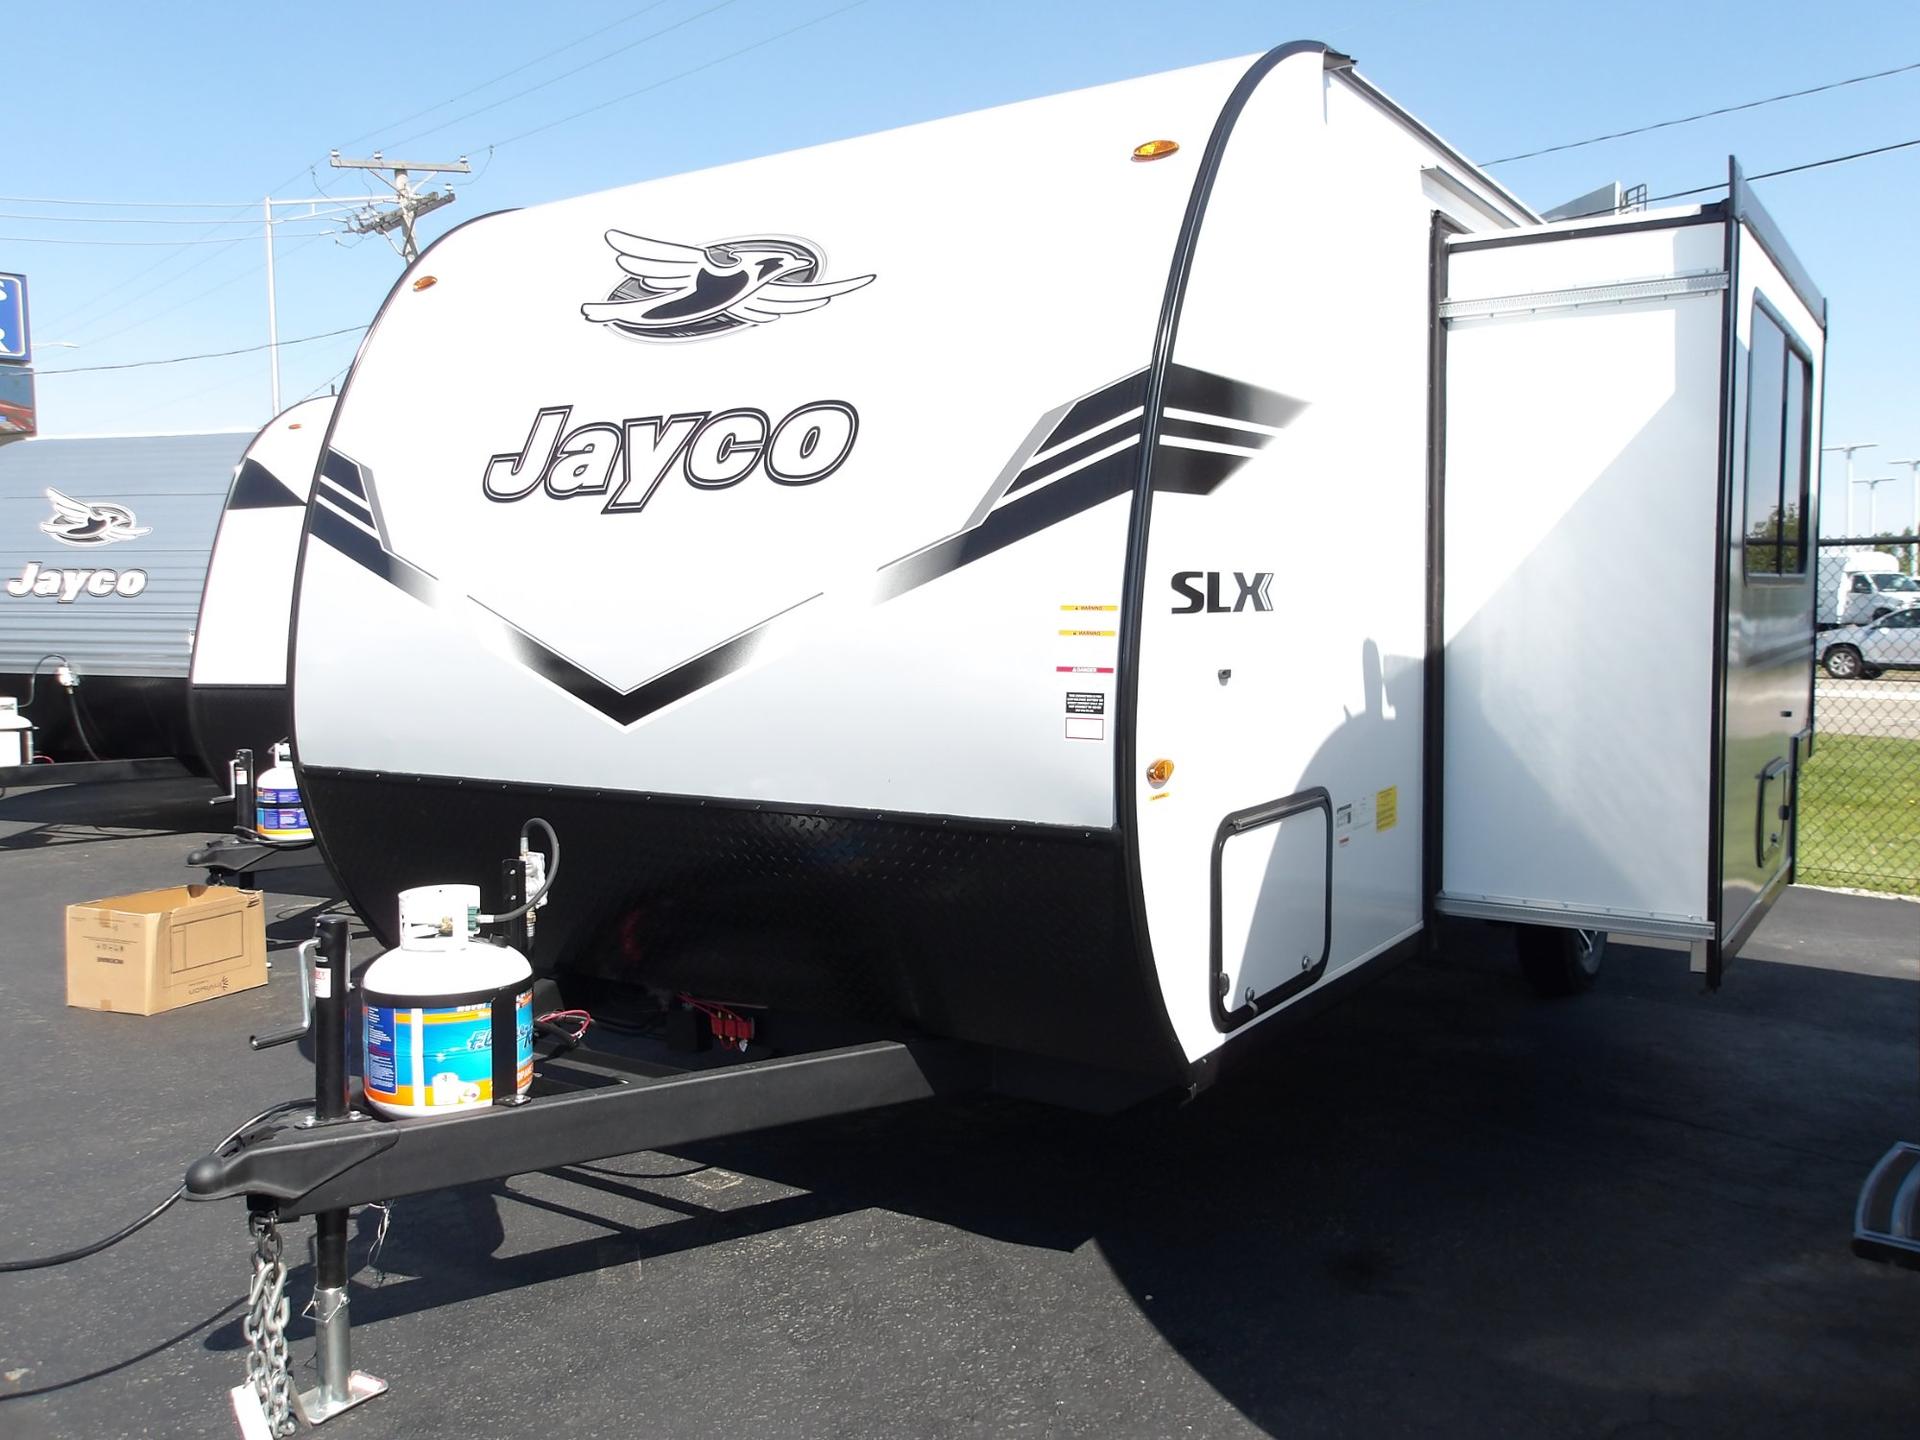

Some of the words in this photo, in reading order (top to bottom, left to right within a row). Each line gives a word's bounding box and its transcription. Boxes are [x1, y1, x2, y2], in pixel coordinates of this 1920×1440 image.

[483, 400, 859, 514] Jayco
[7, 561, 148, 604] Jayco
[1171, 571, 1274, 614] SLX
